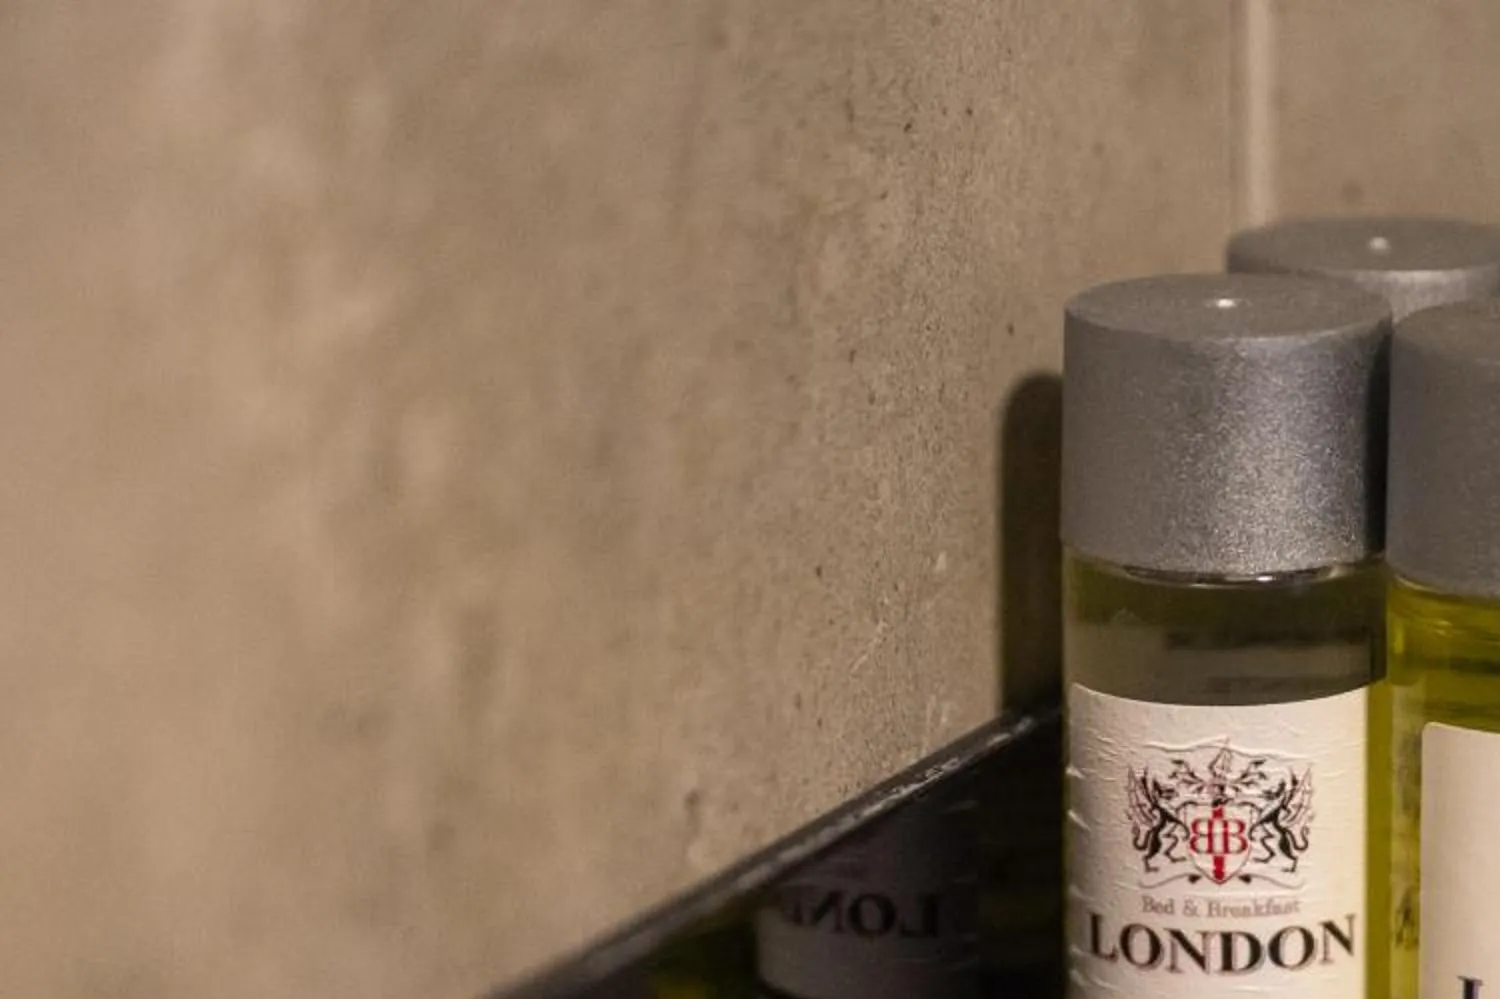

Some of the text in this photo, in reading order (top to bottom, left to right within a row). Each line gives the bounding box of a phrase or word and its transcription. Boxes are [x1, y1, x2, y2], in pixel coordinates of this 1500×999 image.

[1141, 895, 1301, 920] Bed & Breakfast
[1087, 912, 1356, 976] LONDON
